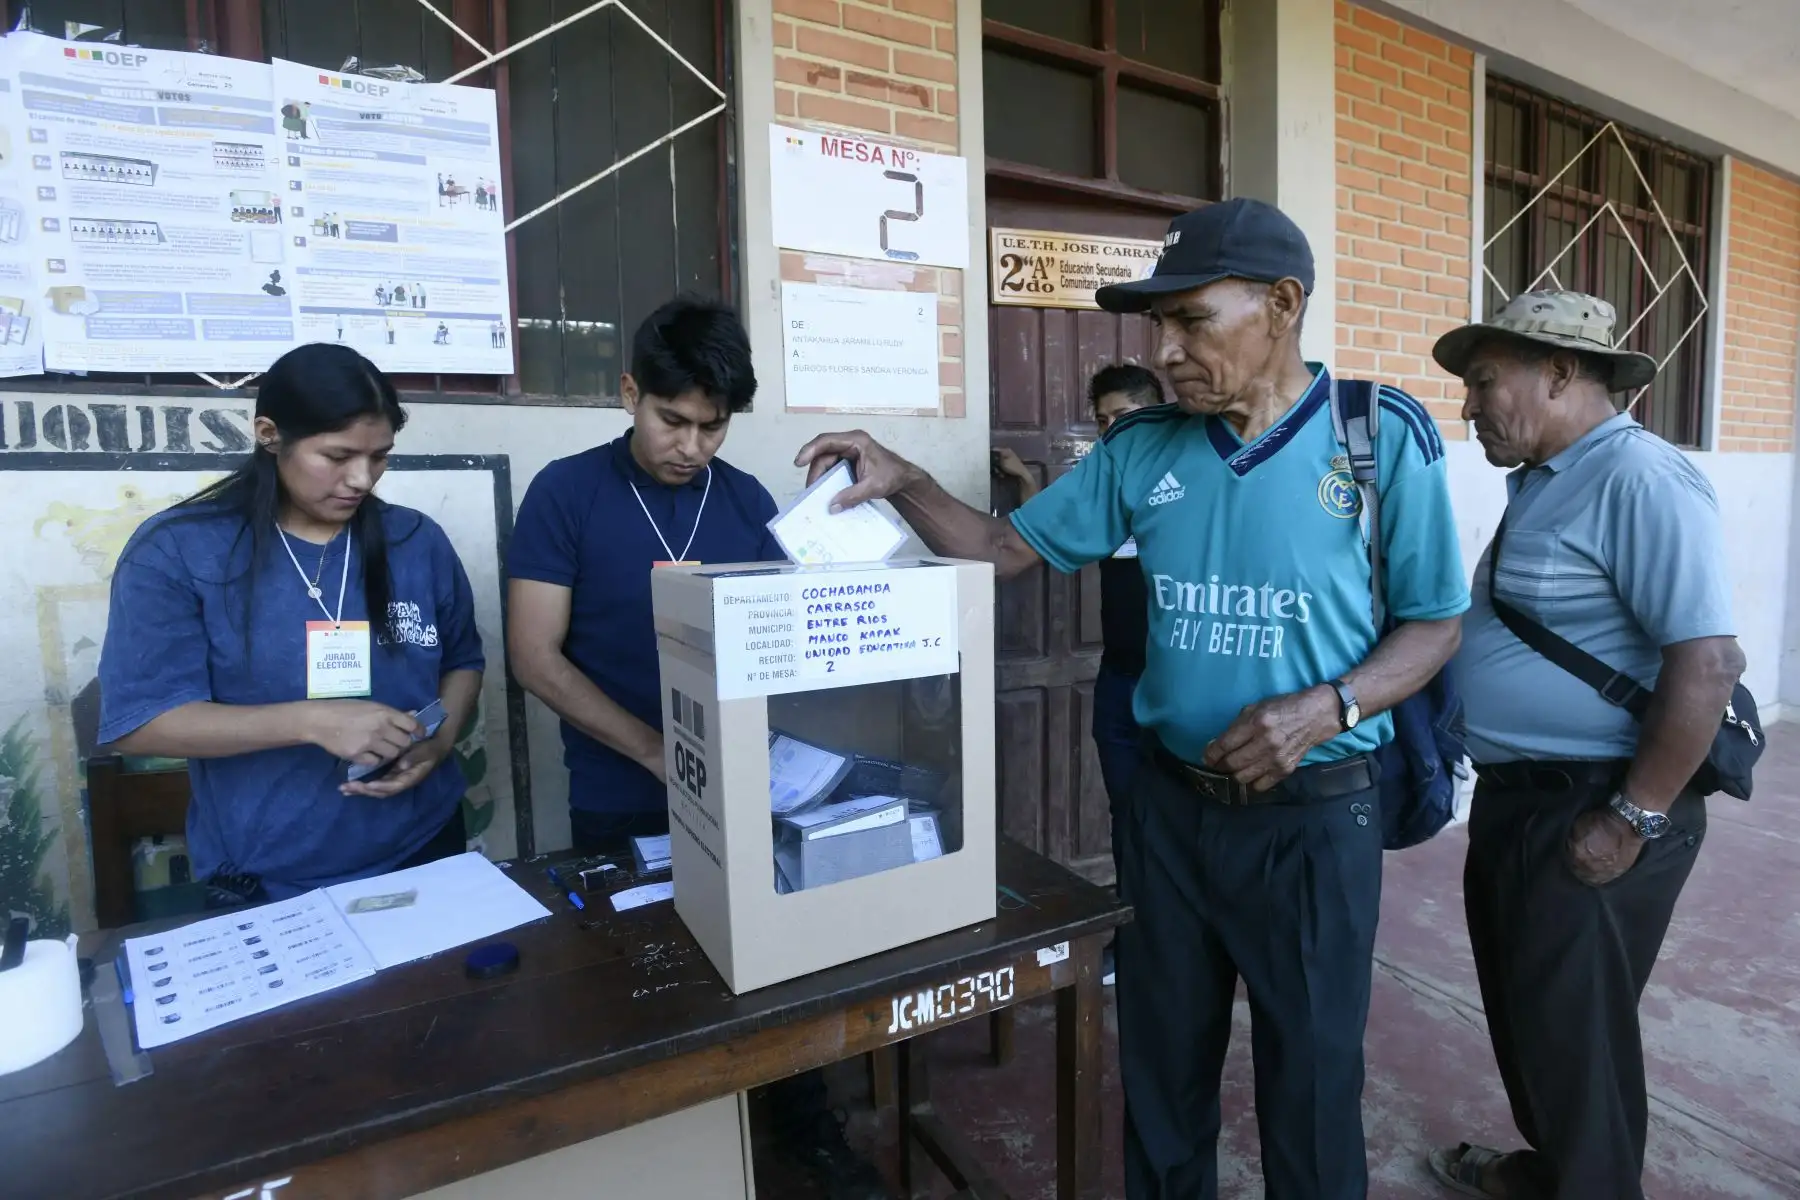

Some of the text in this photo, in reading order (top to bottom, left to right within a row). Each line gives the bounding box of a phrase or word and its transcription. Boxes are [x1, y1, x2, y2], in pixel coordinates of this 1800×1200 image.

[106, 51, 147, 67] OEP
[353, 81, 389, 97] OEP
[821, 136, 885, 165] MESA
[879, 170, 923, 261] 2
[1003, 238, 1057, 252] U.E.T.H.
[1061, 242, 1099, 255] JOSE
[1000, 254, 1024, 292] 2
[1060, 260, 1132, 278] Educación Secundaria
[1026, 280, 1054, 293] do
[1060, 275, 1099, 290] Comunitaria
[918, 308, 924, 316] 2
[828, 365, 859, 373] FLORES
[861, 366, 891, 374] SANDRA
[892, 367, 928, 375] VERONICA
[1149, 486, 1186, 506] adidas
[724, 583, 891, 605] DEPARTAMENTO: COCHABAMBA
[1153, 574, 1313, 623] Emirates
[748, 600, 876, 620] PROVINCIA: CARRASCO
[748, 614, 888, 636] MUNICIPIO: ENTRE RIOS
[746, 627, 901, 651] LOCALIDAD: MANCO KAPAK
[1170, 617, 1283, 658] FLY BETTER
[316, 660, 362, 670] ELECTORAL
[324, 653, 356, 662] JURADO
[758, 654, 796, 666] RECINTO:
[805, 646, 850, 659] UNIDAD
[760, 670, 770, 681] DE
[772, 668, 798, 680] MESA:
[826, 660, 836, 672] 2
[675, 741, 707, 800] OEP
